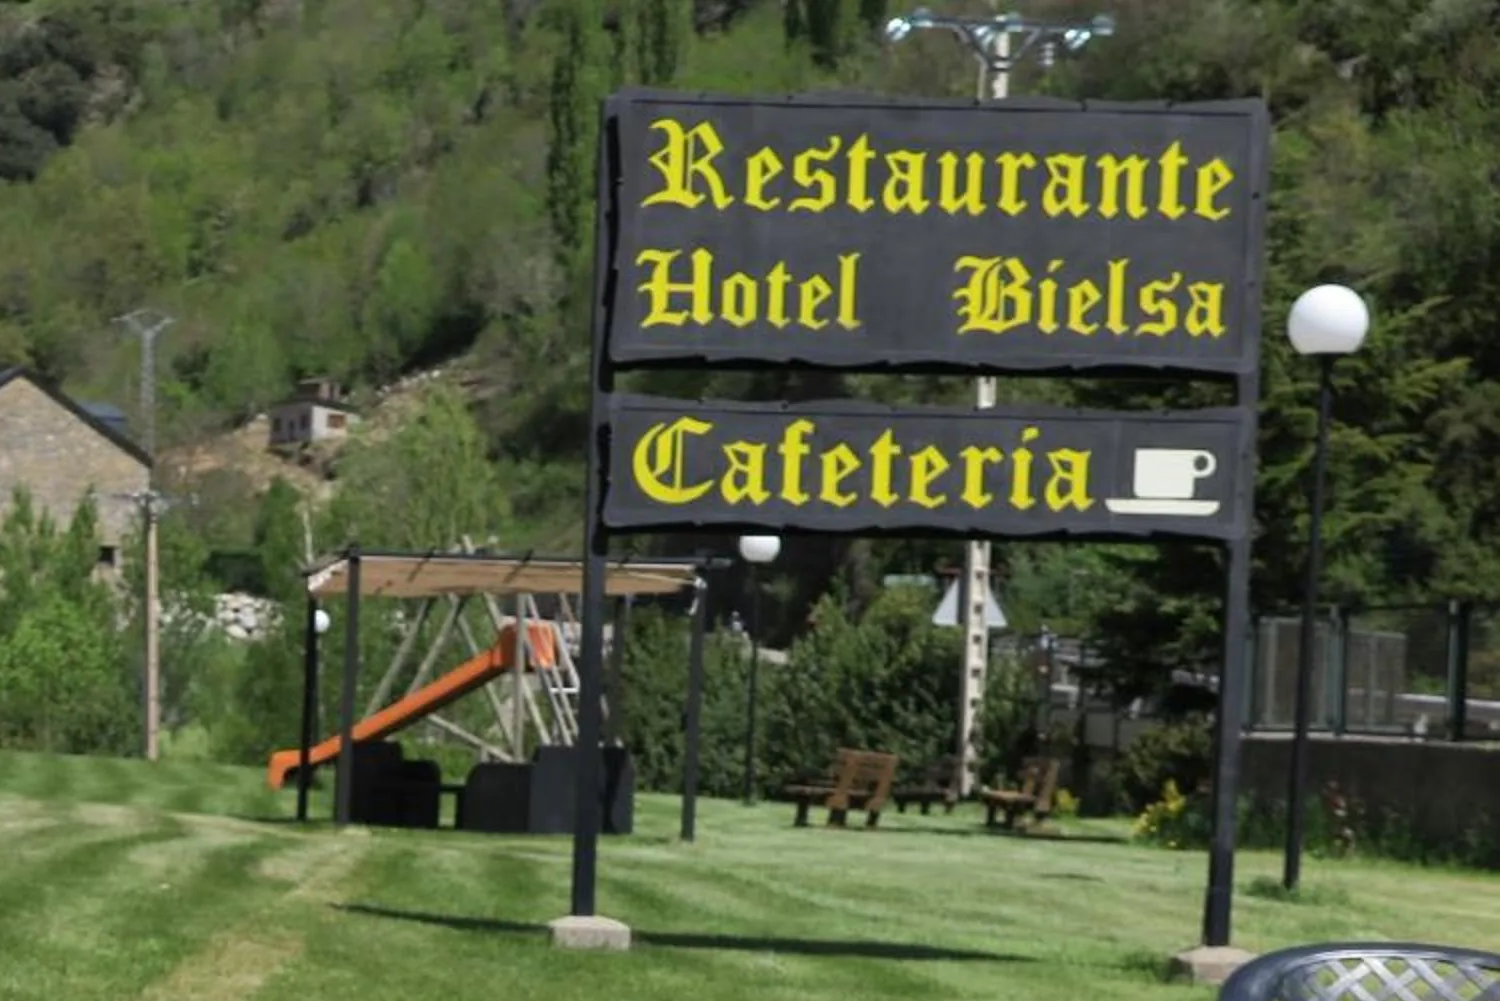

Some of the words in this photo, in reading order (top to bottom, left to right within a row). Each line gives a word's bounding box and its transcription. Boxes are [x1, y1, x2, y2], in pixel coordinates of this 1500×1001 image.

[639, 117, 1236, 220] Restaurante
[635, 247, 862, 329] Hotel
[953, 254, 1227, 337] Bielsa
